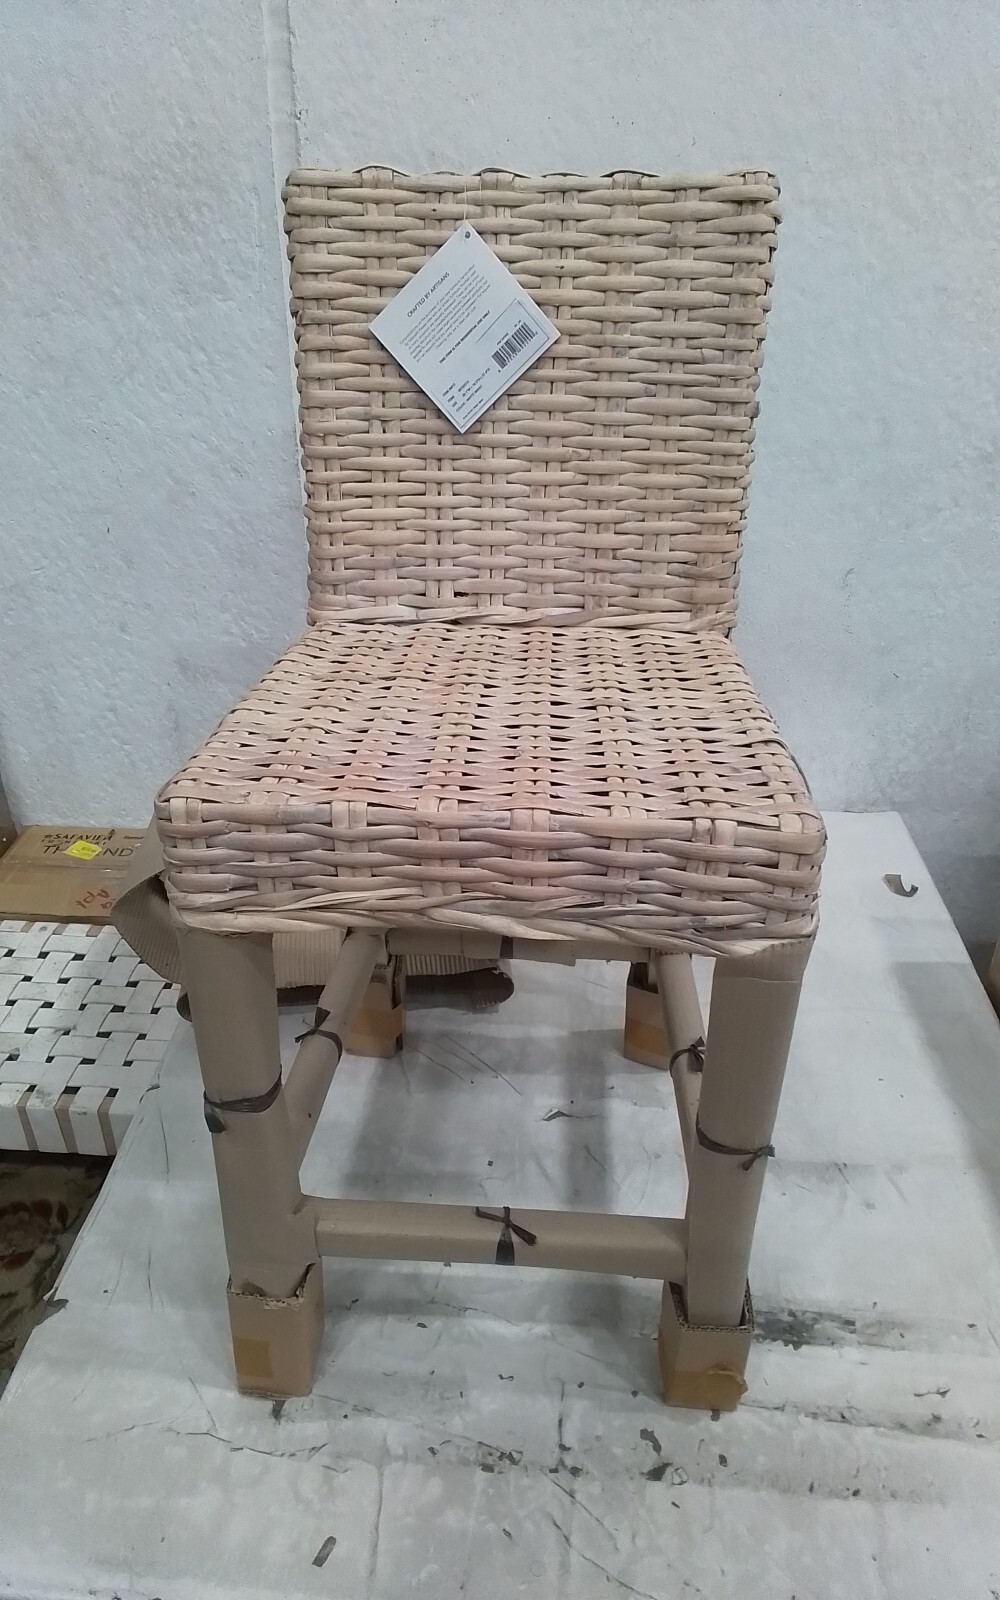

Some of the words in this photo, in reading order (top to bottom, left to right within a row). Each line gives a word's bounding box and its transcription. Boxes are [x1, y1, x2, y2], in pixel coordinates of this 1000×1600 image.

[407, 297, 425, 317] CRAFTED
[424, 291, 431, 299] BY
[429, 271, 449, 293] ARTISANS
